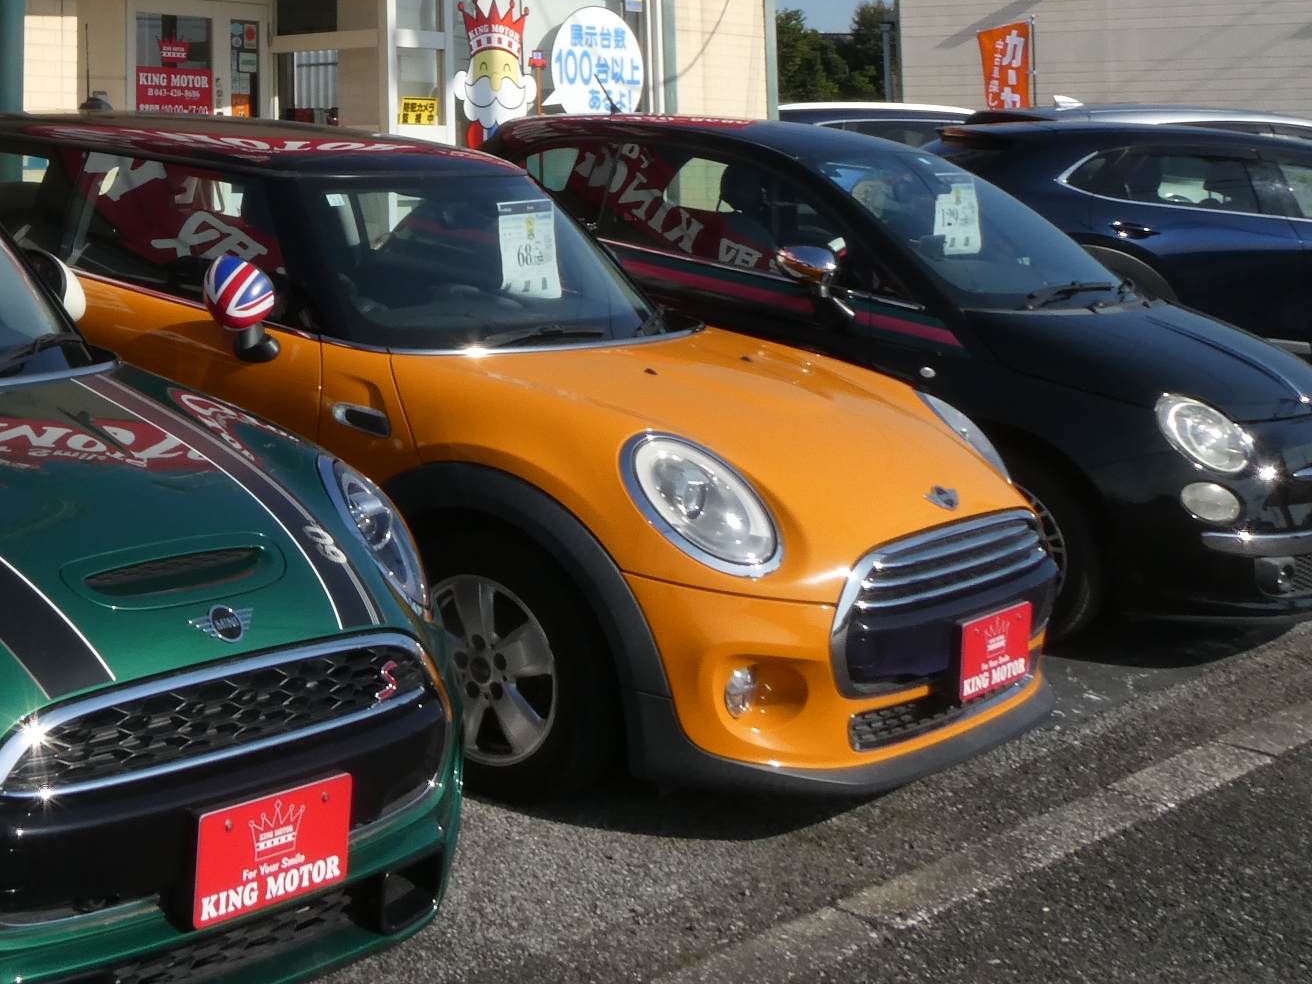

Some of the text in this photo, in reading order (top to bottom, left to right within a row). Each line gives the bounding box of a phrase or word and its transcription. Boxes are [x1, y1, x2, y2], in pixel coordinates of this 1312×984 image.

[468, 24, 520, 42] KING MOTOR
[570, 24, 626, 49] 展示台数
[139, 72, 209, 88] KING MOTOR
[555, 49, 641, 85] 100台以上
[988, 38, 1005, 109] 中古車探し
[403, 102, 435, 113] 防犯カメラ
[214, 616, 238, 630] MINI
[963, 657, 1026, 696] KING MOTOR
[242, 853, 305, 881] For Your Smile
[200, 855, 341, 921] KING MOTOR
